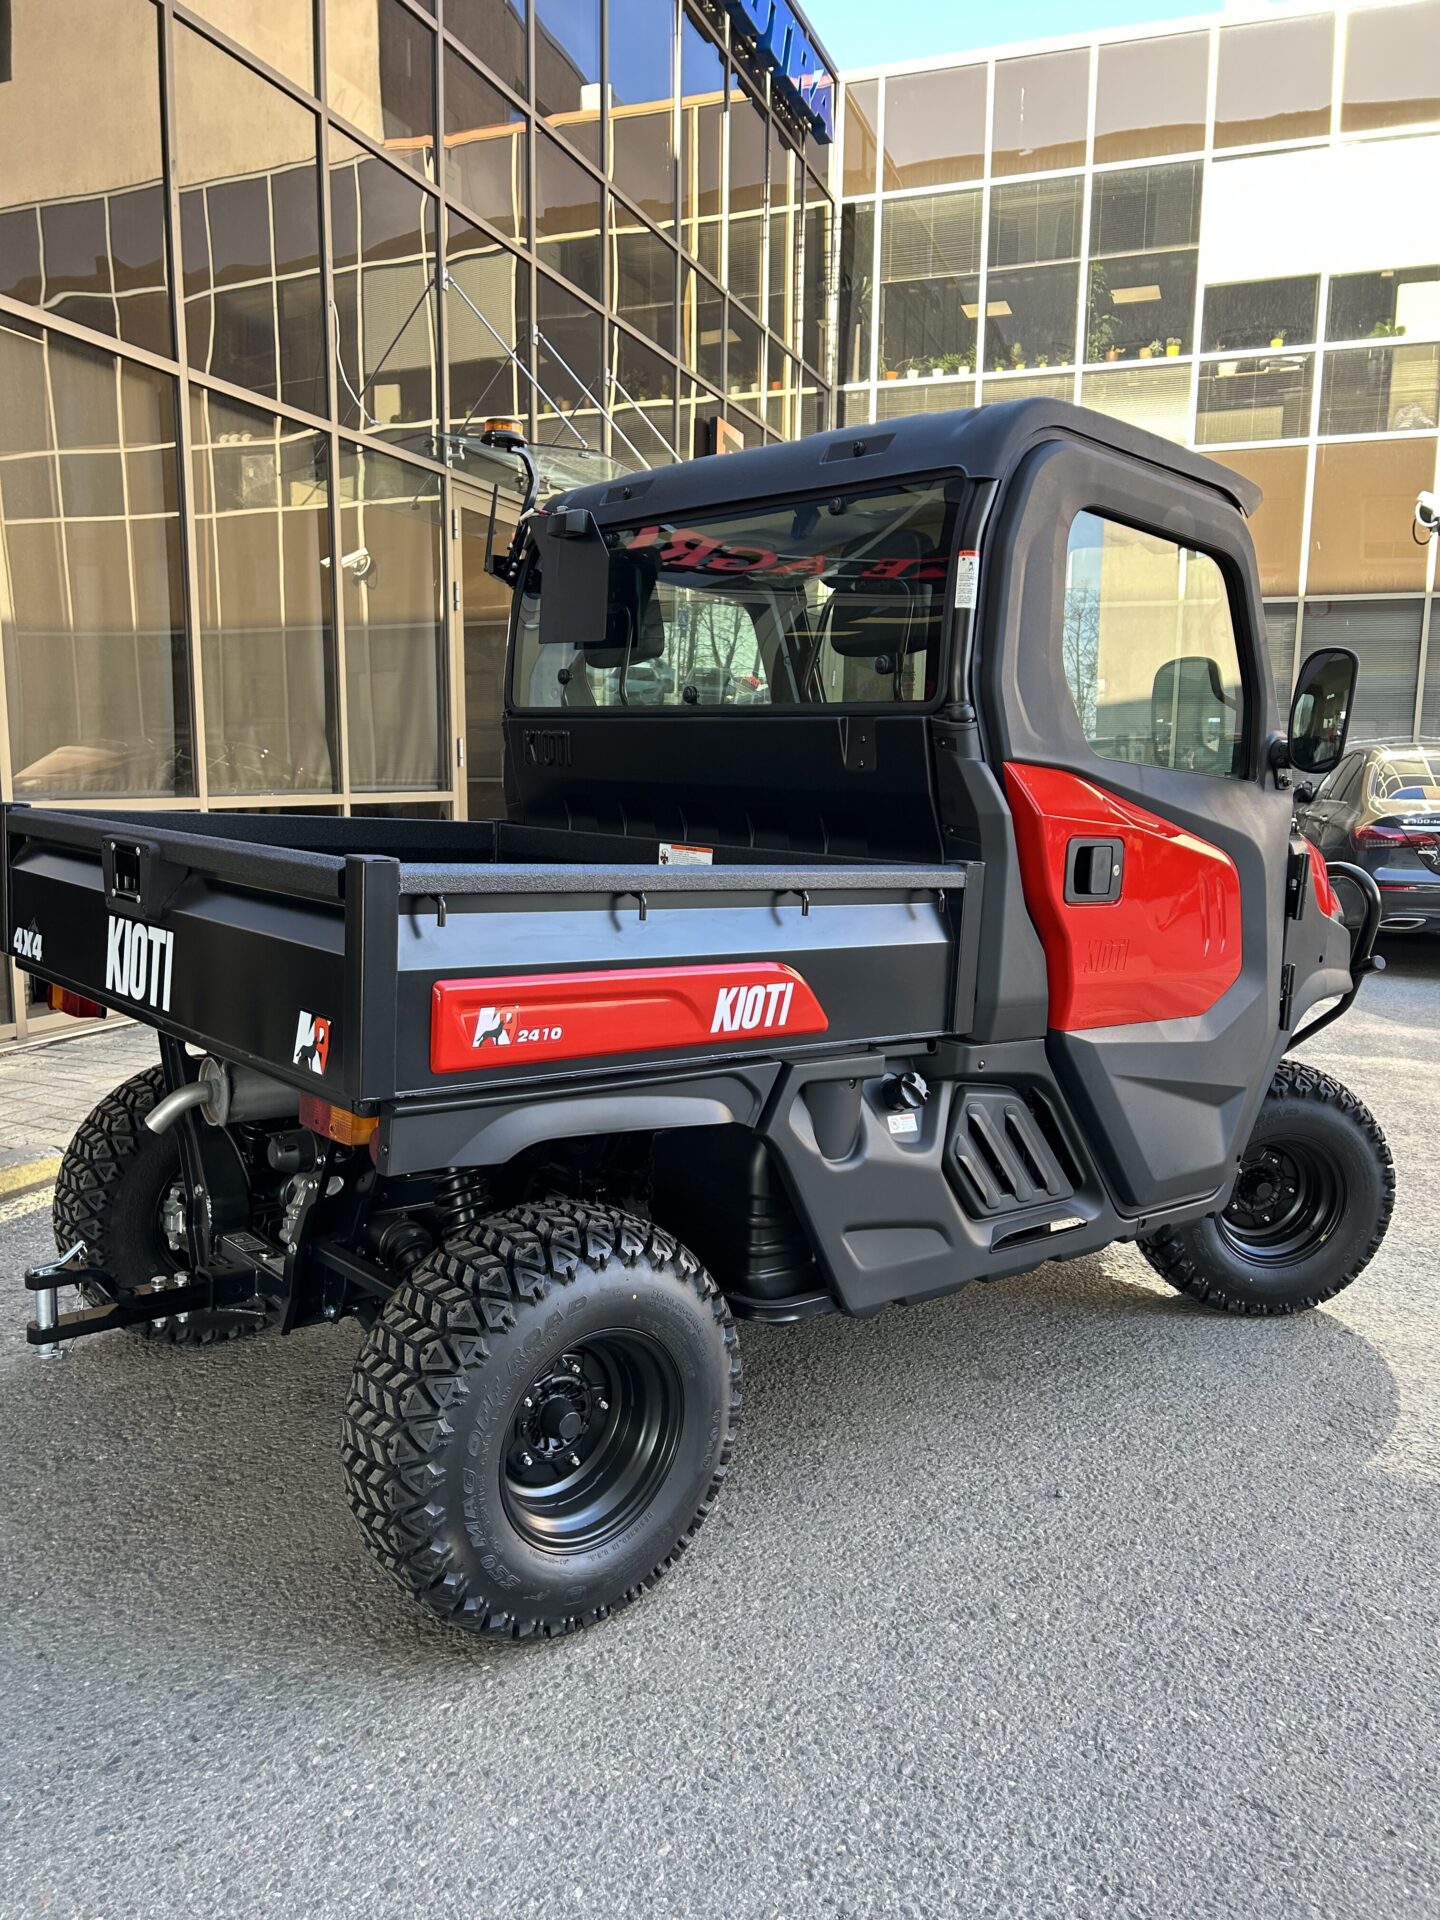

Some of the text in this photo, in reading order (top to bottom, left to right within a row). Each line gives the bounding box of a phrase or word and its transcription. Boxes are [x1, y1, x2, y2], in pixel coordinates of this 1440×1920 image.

[13, 926, 43, 961] 4X4
[105, 915, 174, 1013] KIOTI
[710, 982, 794, 1034] KIOTI
[516, 1026, 563, 1043] 2410
